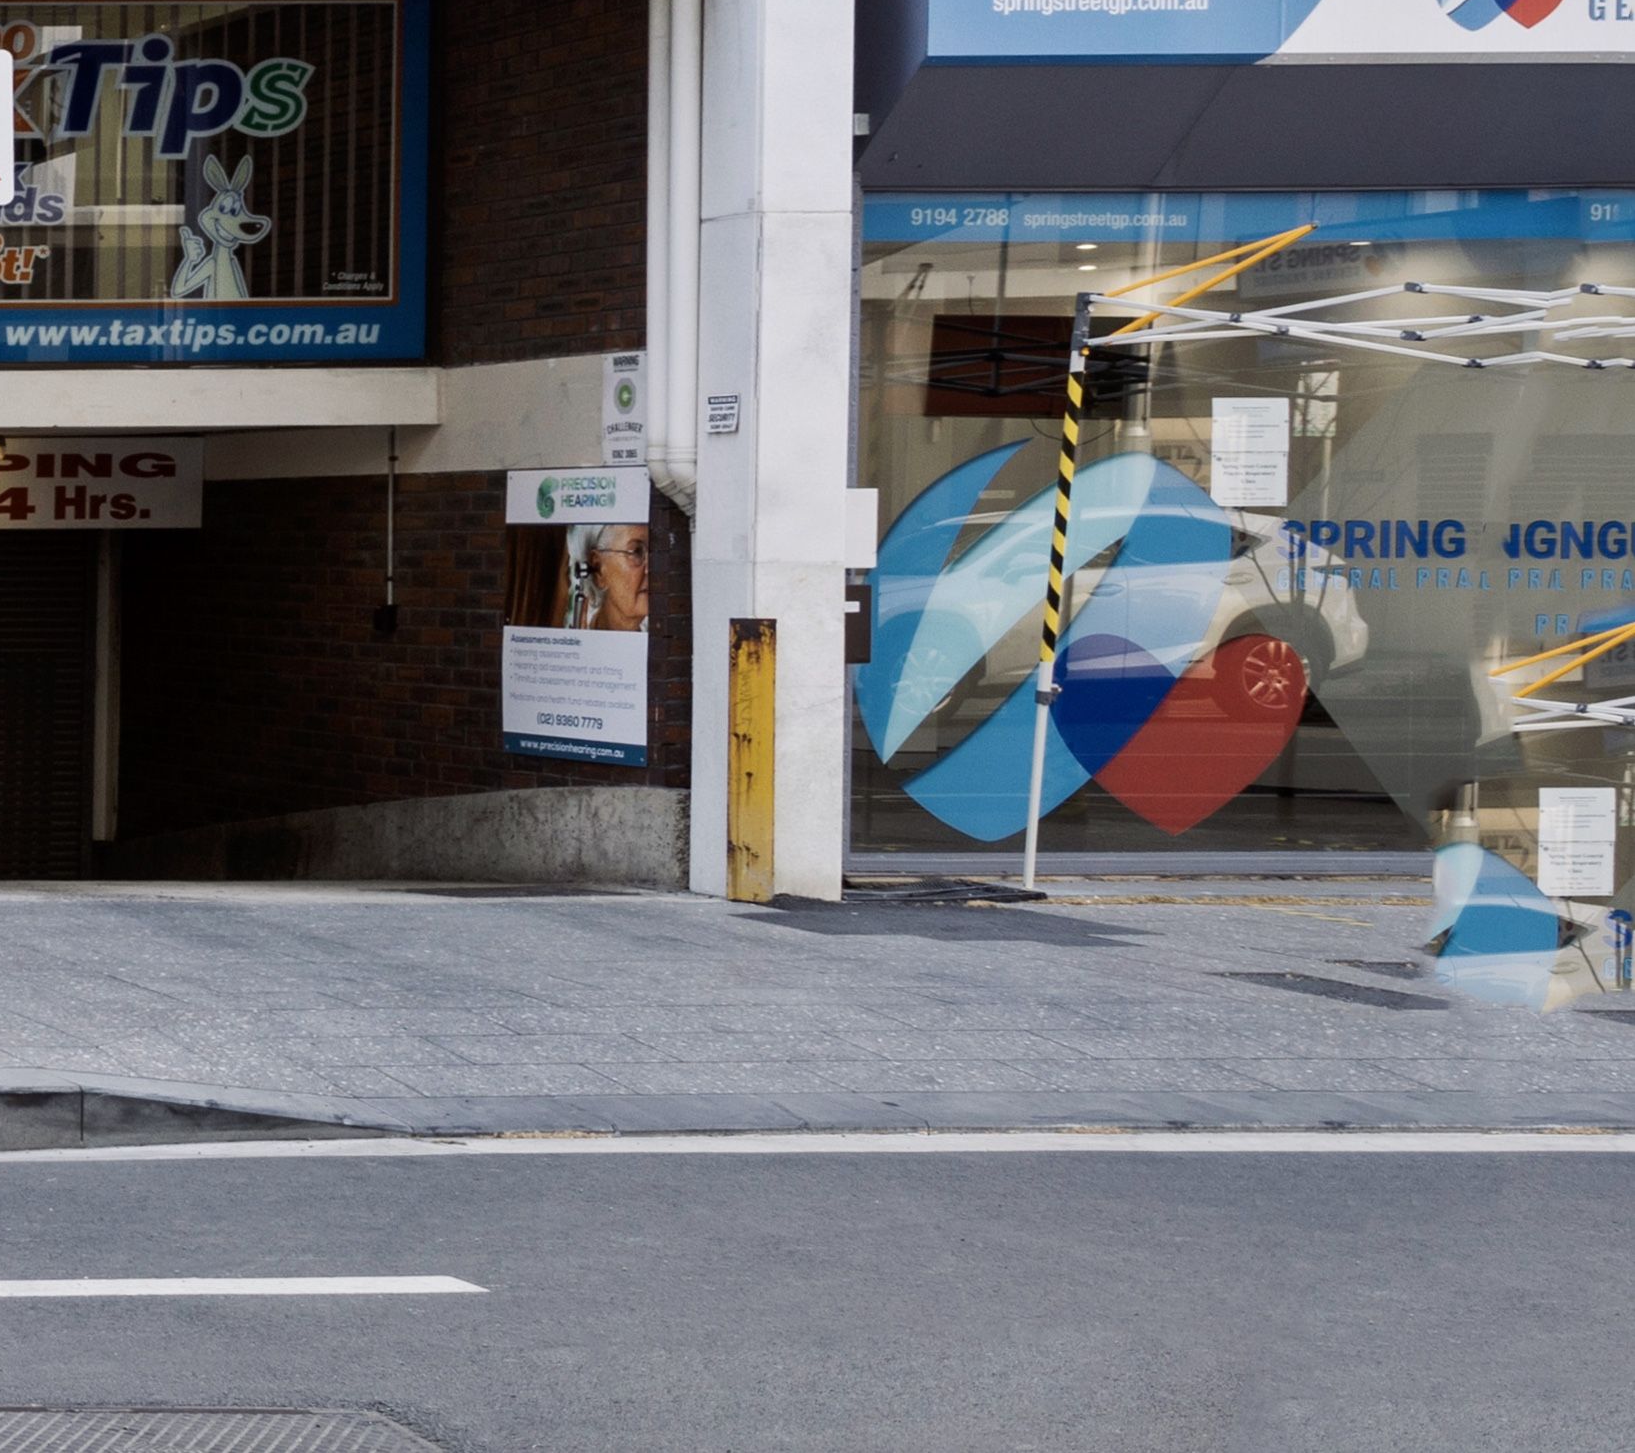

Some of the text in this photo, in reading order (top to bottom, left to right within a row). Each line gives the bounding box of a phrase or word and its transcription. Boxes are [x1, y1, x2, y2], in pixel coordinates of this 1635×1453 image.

[911, 207, 1188, 231] 9194 2788 springstreetgp.com.au
[4, 316, 381, 353] www.taxtips.com.au
[560, 476, 617, 491] PRECISION
[54, 485, 151, 521] Hrs.
[560, 494, 608, 508] HEARING
[1276, 519, 1466, 560] SPRING
[510, 634, 552, 646] Assessments
[536, 713, 604, 730] (02) 9360 7779
[519, 739, 625, 760] www.precisionhearing.com.au
